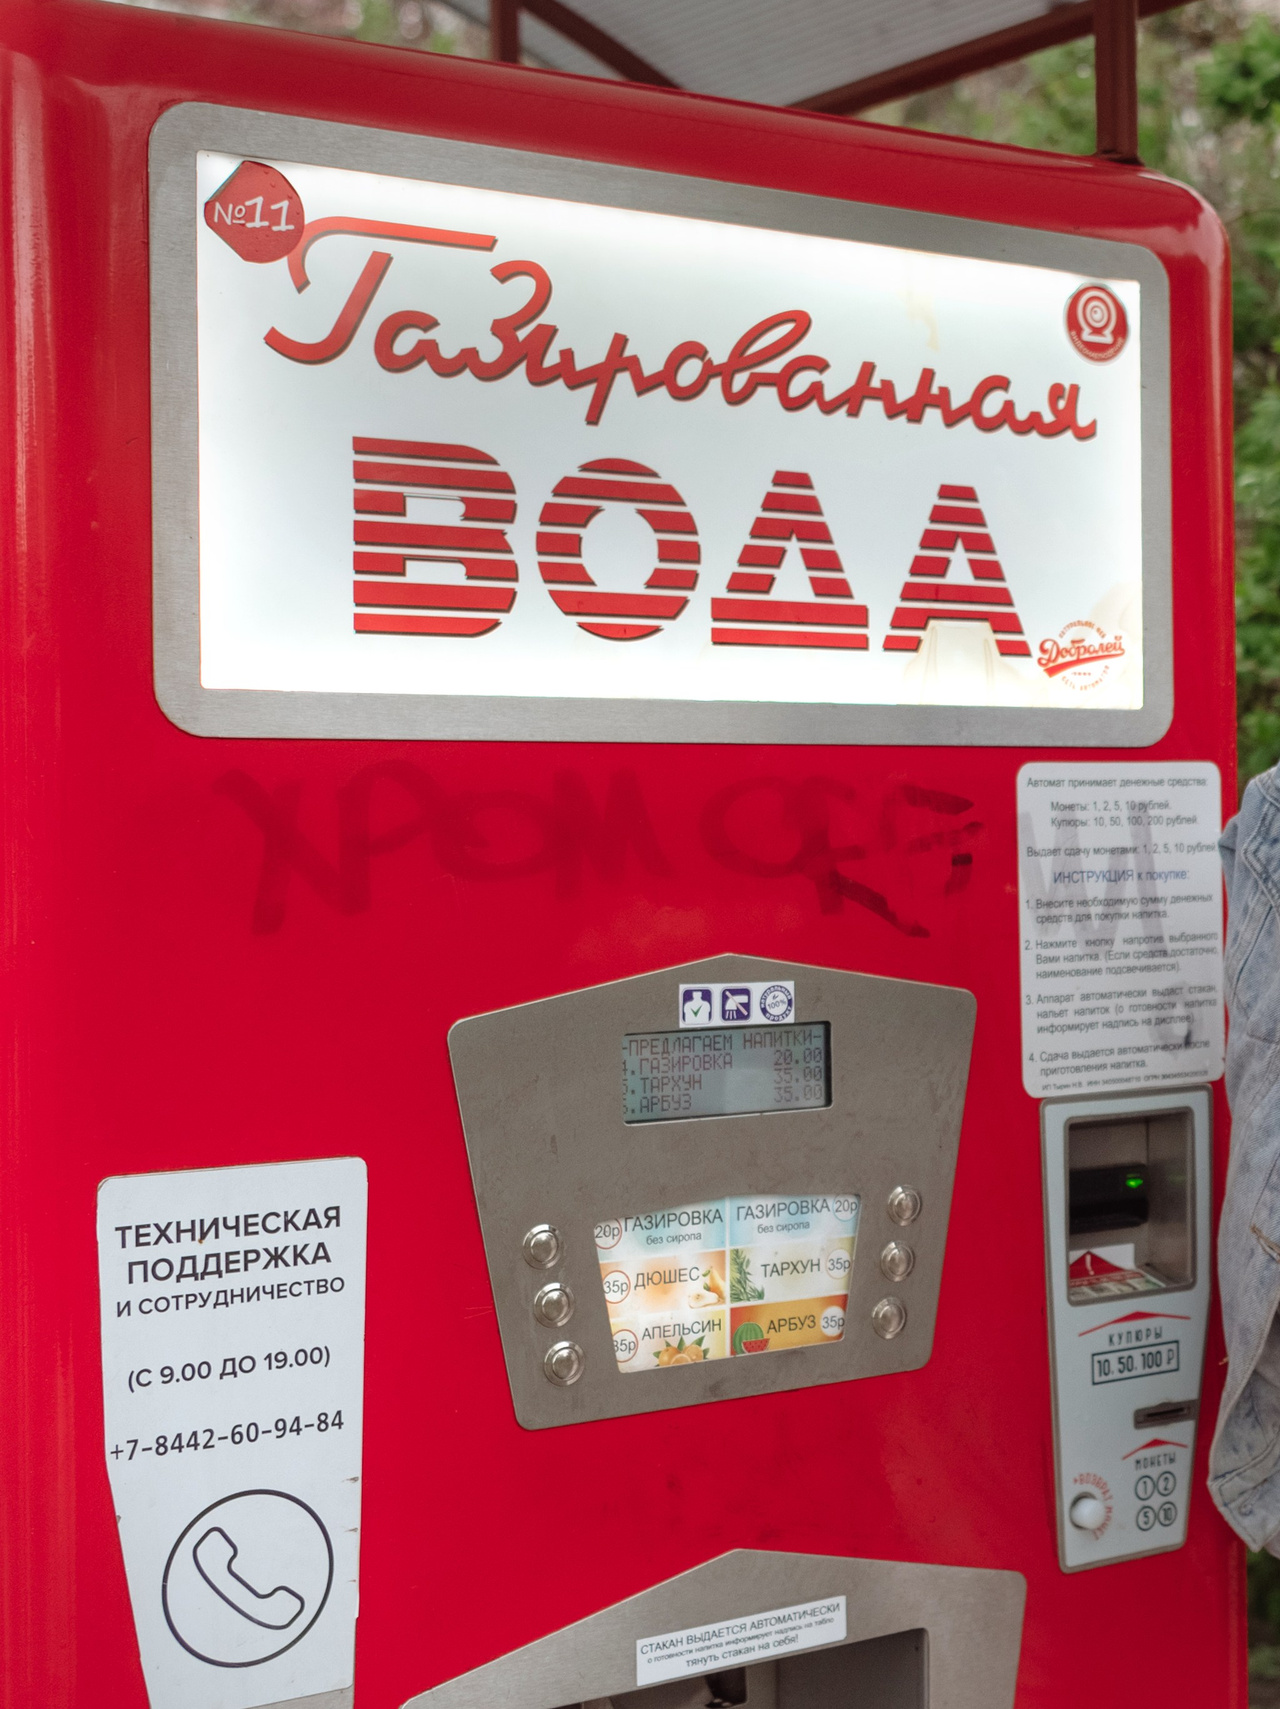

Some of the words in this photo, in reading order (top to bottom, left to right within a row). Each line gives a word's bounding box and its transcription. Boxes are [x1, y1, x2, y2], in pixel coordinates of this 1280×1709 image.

[213, 195, 295, 232] №11
[264, 216, 1098, 441] Газированная
[352, 436, 1033, 658] ВОДА
[1037, 635, 1125, 668] Добролей
[1026, 777, 1065, 788] Автомат
[1068, 778, 1117, 789] принимает
[1119, 777, 1165, 788] денежные
[1167, 776, 1208, 788] средства:
[1051, 801, 1089, 812] Монеты:
[1125, 800, 1136, 811] 10
[1051, 817, 1090, 829] Купюры:
[1147, 815, 1163, 827] 200
[1027, 846, 1062, 857] Выдает
[1064, 846, 1091, 858] сдачу
[1053, 869, 1134, 884] ИНСТРУКЦИЯ
[1137, 873, 1144, 881] к
[1146, 870, 1189, 883] покупке:
[1036, 899, 1074, 910] Внесите
[1076, 897, 1138, 908] необходимую
[1140, 896, 1168, 907] сумму
[1170, 893, 1213, 905] денежных
[1036, 913, 1072, 925] средств
[1075, 913, 1092, 924] для
[1095, 911, 1130, 923] покупки
[1036, 938, 1077, 950] Нажмите
[1085, 936, 1115, 949] кнопку
[1123, 935, 1164, 947] напротив
[1036, 953, 1060, 965] Вами
[1105, 949, 1130, 964] (Если
[1133, 948, 1168, 960] средств
[1036, 967, 1103, 980] наименование
[1036, 992, 1075, 1005] Аппарат
[1080, 989, 1147, 1002] автоматически
[1152, 986, 1184, 998] выдаст
[1037, 1008, 1068, 1020] нальет
[1074, 1006, 1110, 1018] напиток
[1129, 1001, 1177, 1013] готовности
[1184, 998, 1217, 1010] напитка
[1037, 1019, 1099, 1034] информирует
[1102, 1018, 1139, 1030] надпись
[1141, 1016, 1152, 1026] на
[640, 1053, 733, 1075] ГАЗИРОВКА
[773, 1048, 822, 1067] 20.00
[1040, 1051, 1069, 1063] Сдача
[1072, 1047, 1115, 1060] выдается
[1117, 1041, 1181, 1056] автоматически
[1040, 1061, 1108, 1077] приготовления
[640, 1074, 702, 1094] ТАРХУН
[773, 1066, 822, 1086] 35.00
[640, 1093, 692, 1113] АРБУЗ
[773, 1084, 822, 1103] 35.00
[736, 1198, 831, 1221] ГАЗИРОВКА
[115, 1205, 341, 1249] ТЕХНИЧЕСКАЯ
[624, 1208, 724, 1232] ГАЗИРОВКА
[757, 1223, 774, 1235] без
[776, 1220, 811, 1233] сиропа
[646, 1234, 664, 1246] без
[666, 1231, 702, 1245] сиропа
[127, 1242, 332, 1284] ПОДДЕРЖКА
[760, 1258, 821, 1278] ТАРХУН
[634, 1266, 701, 1291] ДЮШЕС
[116, 1300, 132, 1317] И
[138, 1276, 345, 1315] СОТРУДНИЧЕСТВО
[641, 1318, 722, 1341] АПЕЛЬСИН
[767, 1314, 817, 1334] АРБУЗ
[1109, 1327, 1162, 1346] КУПЮРЫ
[127, 1369, 152, 1393] (С
[160, 1361, 212, 1385] 9.00
[219, 1355, 256, 1380] ДО
[264, 1345, 331, 1370] 19.00)
[1141, 1350, 1162, 1370] 100
[110, 1410, 345, 1461] +7-8442-60-94-84
[1135, 1452, 1176, 1471] МОНЕТЫ
[1163, 1476, 1171, 1492] 2
[1143, 1510, 1150, 1525] 5
[1163, 1507, 1173, 1522] 10
[640, 1637, 684, 1655] СТАКАН
[686, 1622, 747, 1645] ВЫДАЕТСЯ
[749, 1602, 840, 1631] АВТОМАТИЧЕСКИ
[654, 1649, 693, 1663] готовности
[695, 1642, 724, 1655] напитка
[725, 1630, 773, 1648] информирует
[686, 1653, 719, 1668] тянуть
[721, 1645, 756, 1660] стакан
[758, 1641, 770, 1652] на
[773, 1633, 799, 1648] себя!
